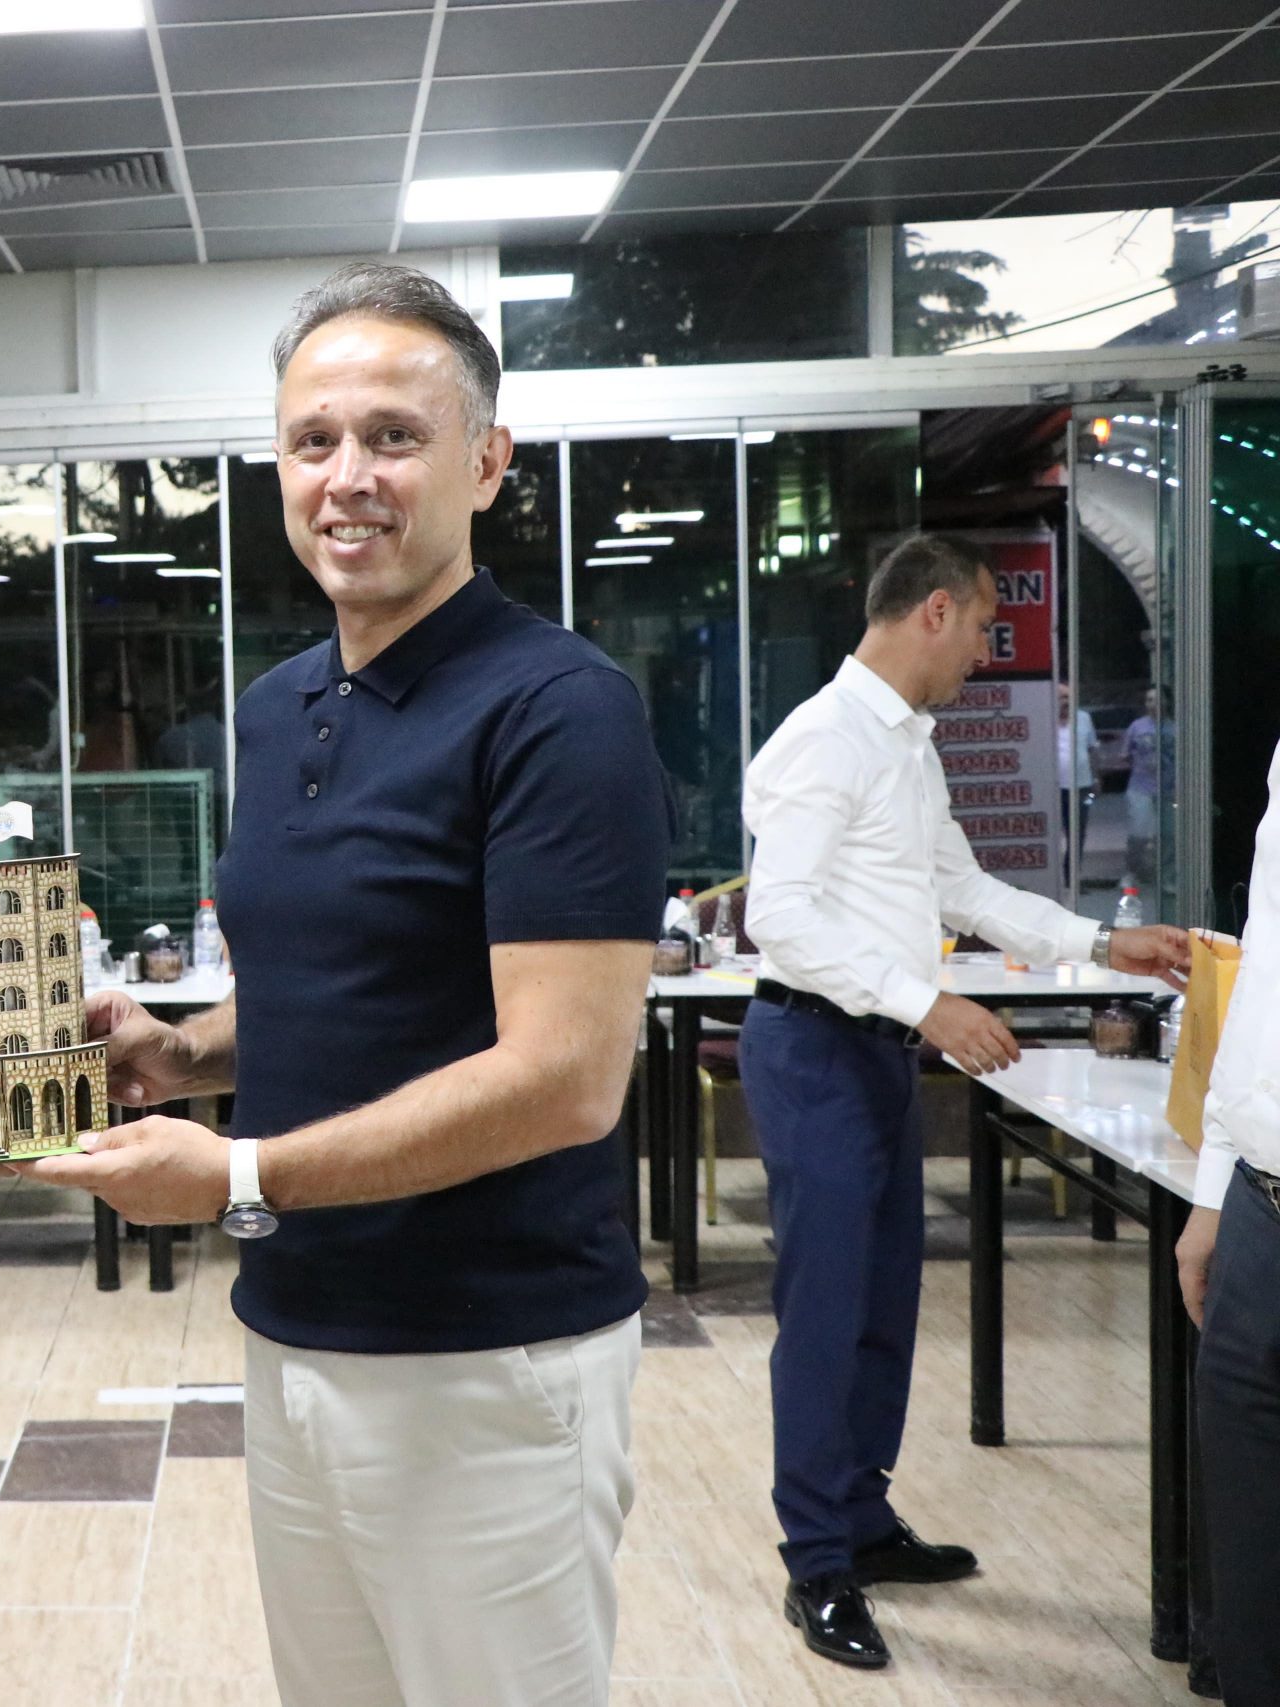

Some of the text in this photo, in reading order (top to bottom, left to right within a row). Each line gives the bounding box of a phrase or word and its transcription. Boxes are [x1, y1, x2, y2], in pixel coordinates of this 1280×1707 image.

[996, 570, 1045, 606] AN
[931, 715, 1028, 742] SMANİYE
[941, 751, 1021, 773] AYMAK
[951, 782, 1030, 807] ERLEME
[961, 813, 1047, 838] URMALI
[973, 846, 1047, 870] ELVASI
